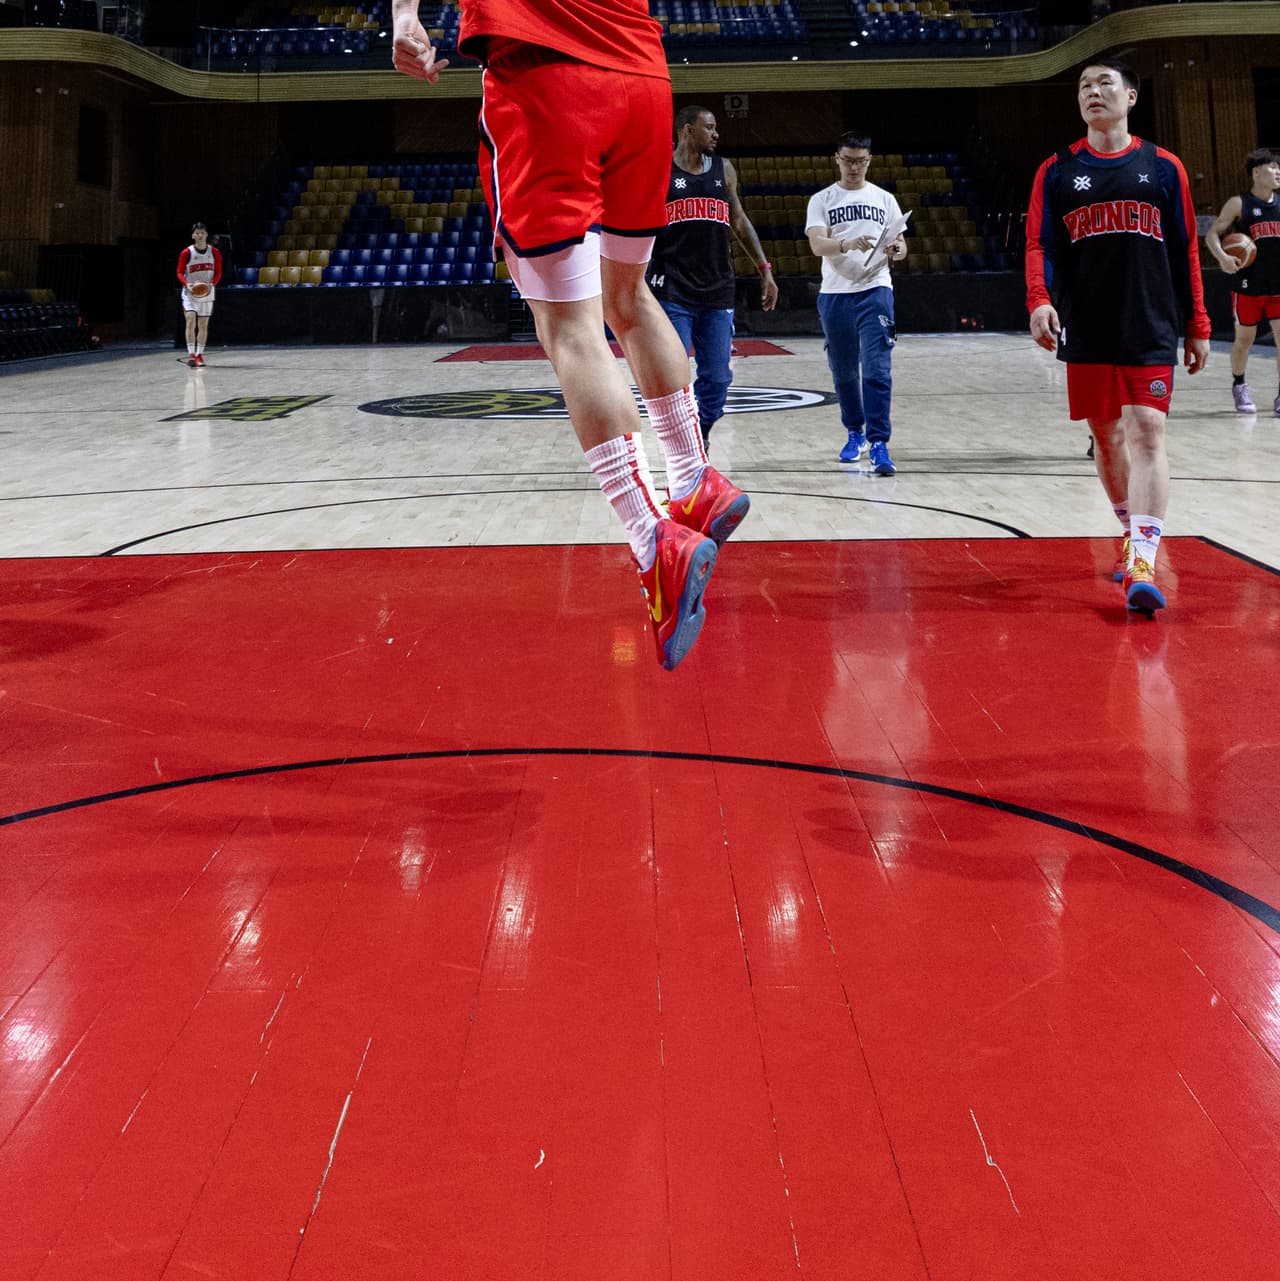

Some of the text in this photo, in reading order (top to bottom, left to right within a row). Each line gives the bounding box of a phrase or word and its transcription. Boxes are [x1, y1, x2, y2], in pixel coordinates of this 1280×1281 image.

[730, 96, 742, 109] D
[828, 204, 886, 226] BRONCOS
[650, 273, 666, 288] 44
